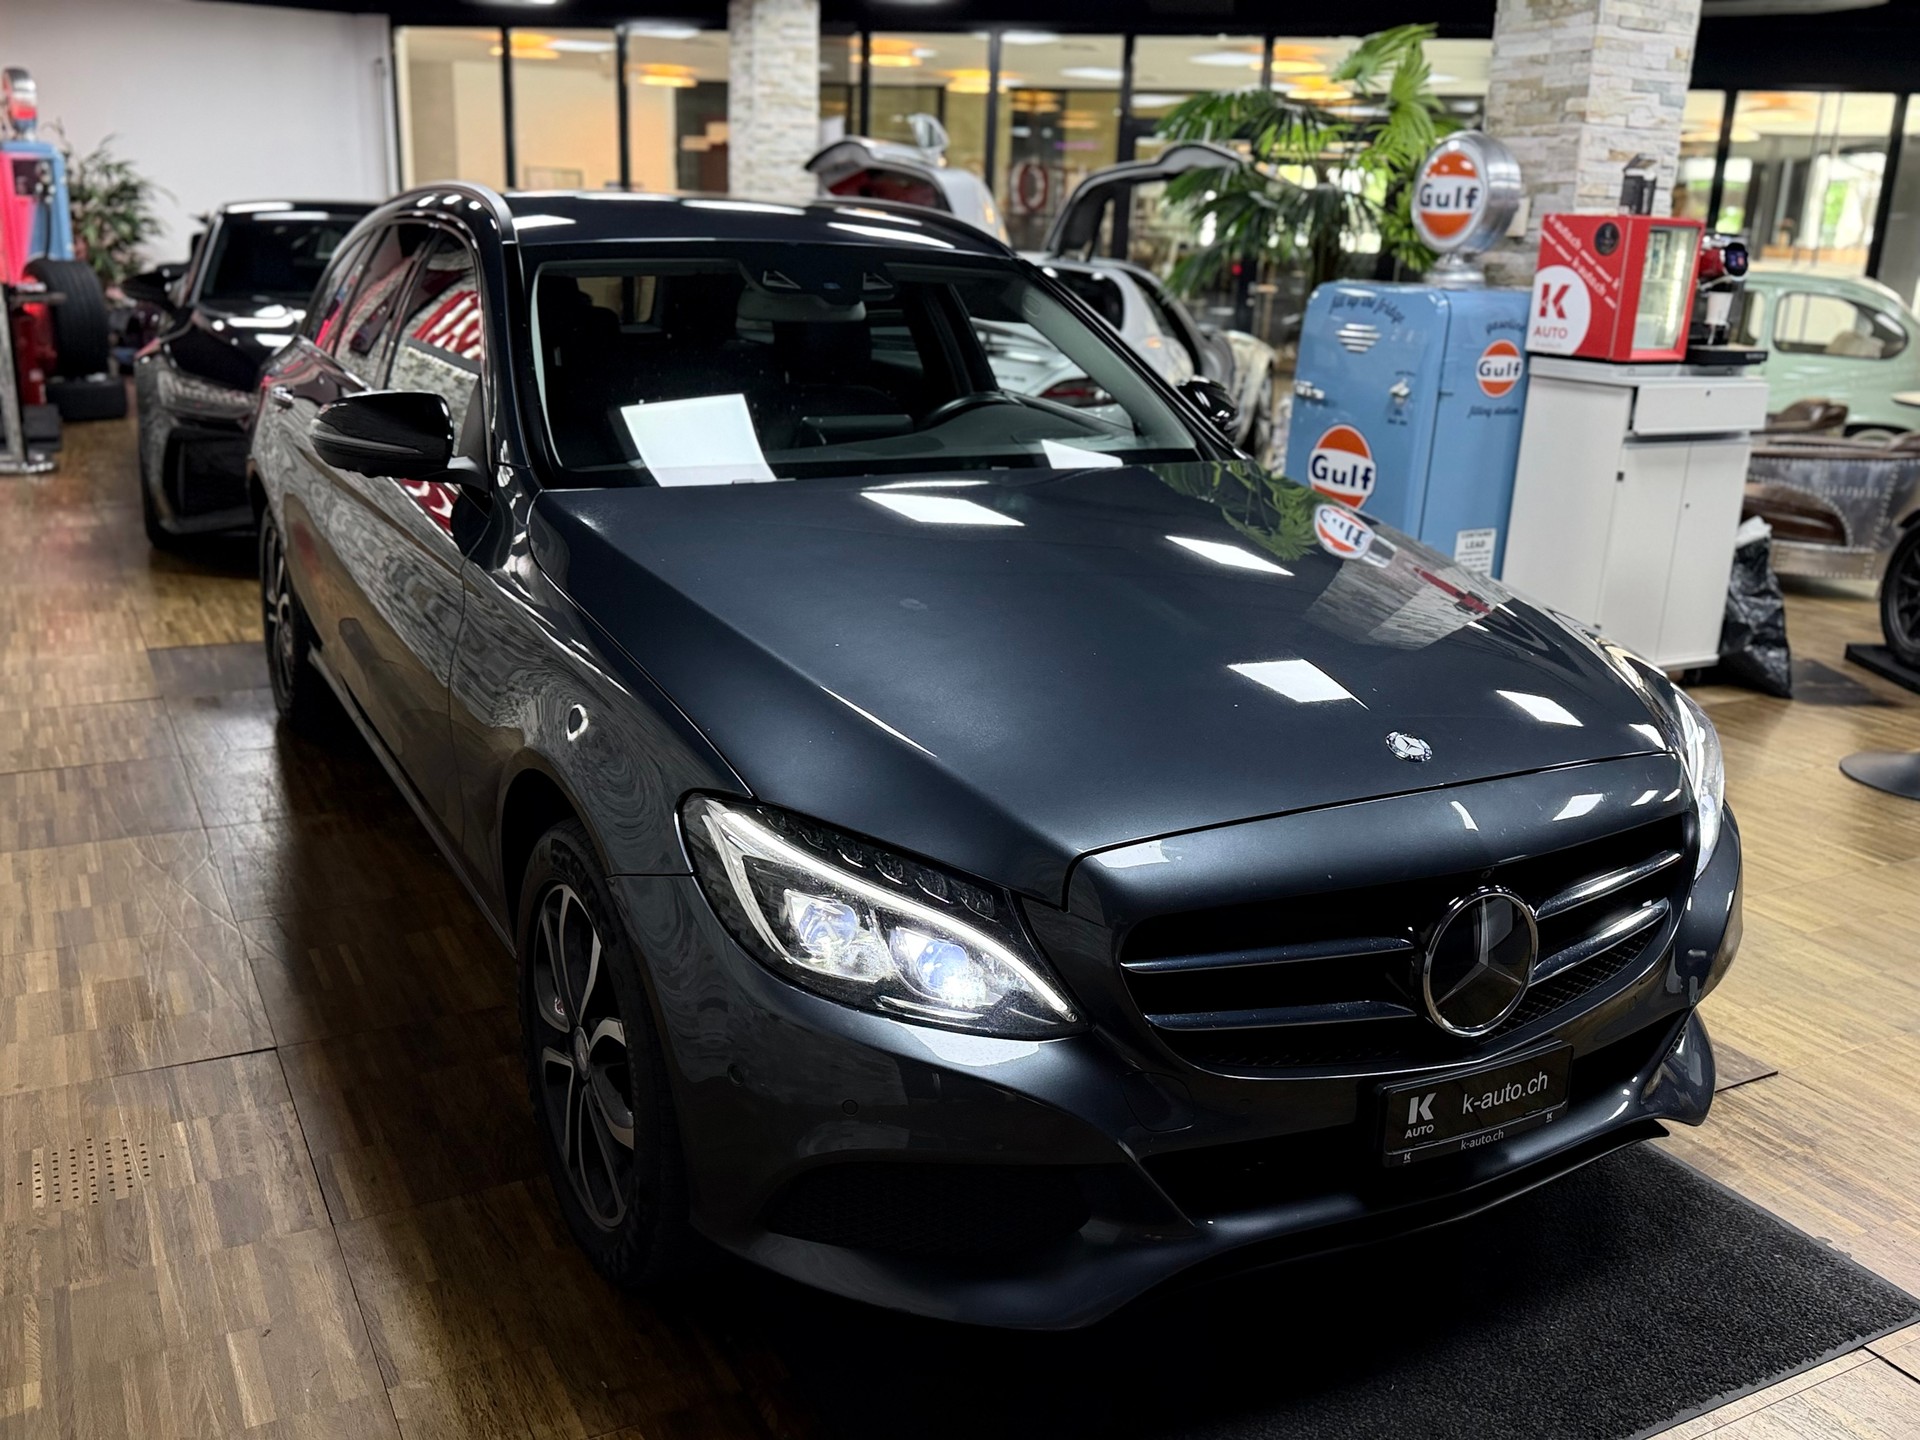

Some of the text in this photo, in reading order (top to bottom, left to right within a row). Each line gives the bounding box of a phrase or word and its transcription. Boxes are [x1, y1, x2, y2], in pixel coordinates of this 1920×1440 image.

[1419, 183, 1479, 208] Gulf
[1538, 283, 1571, 319] K
[1533, 325, 1569, 340] AUTO
[1479, 360, 1521, 377] Gulf
[1312, 454, 1373, 490] Gulf
[1462, 1071, 1548, 1115] k-auto.ch
[1407, 1092, 1437, 1125] K
[1404, 1124, 1434, 1139] AUTO
[1460, 1129, 1504, 1151] k-auto.ch
